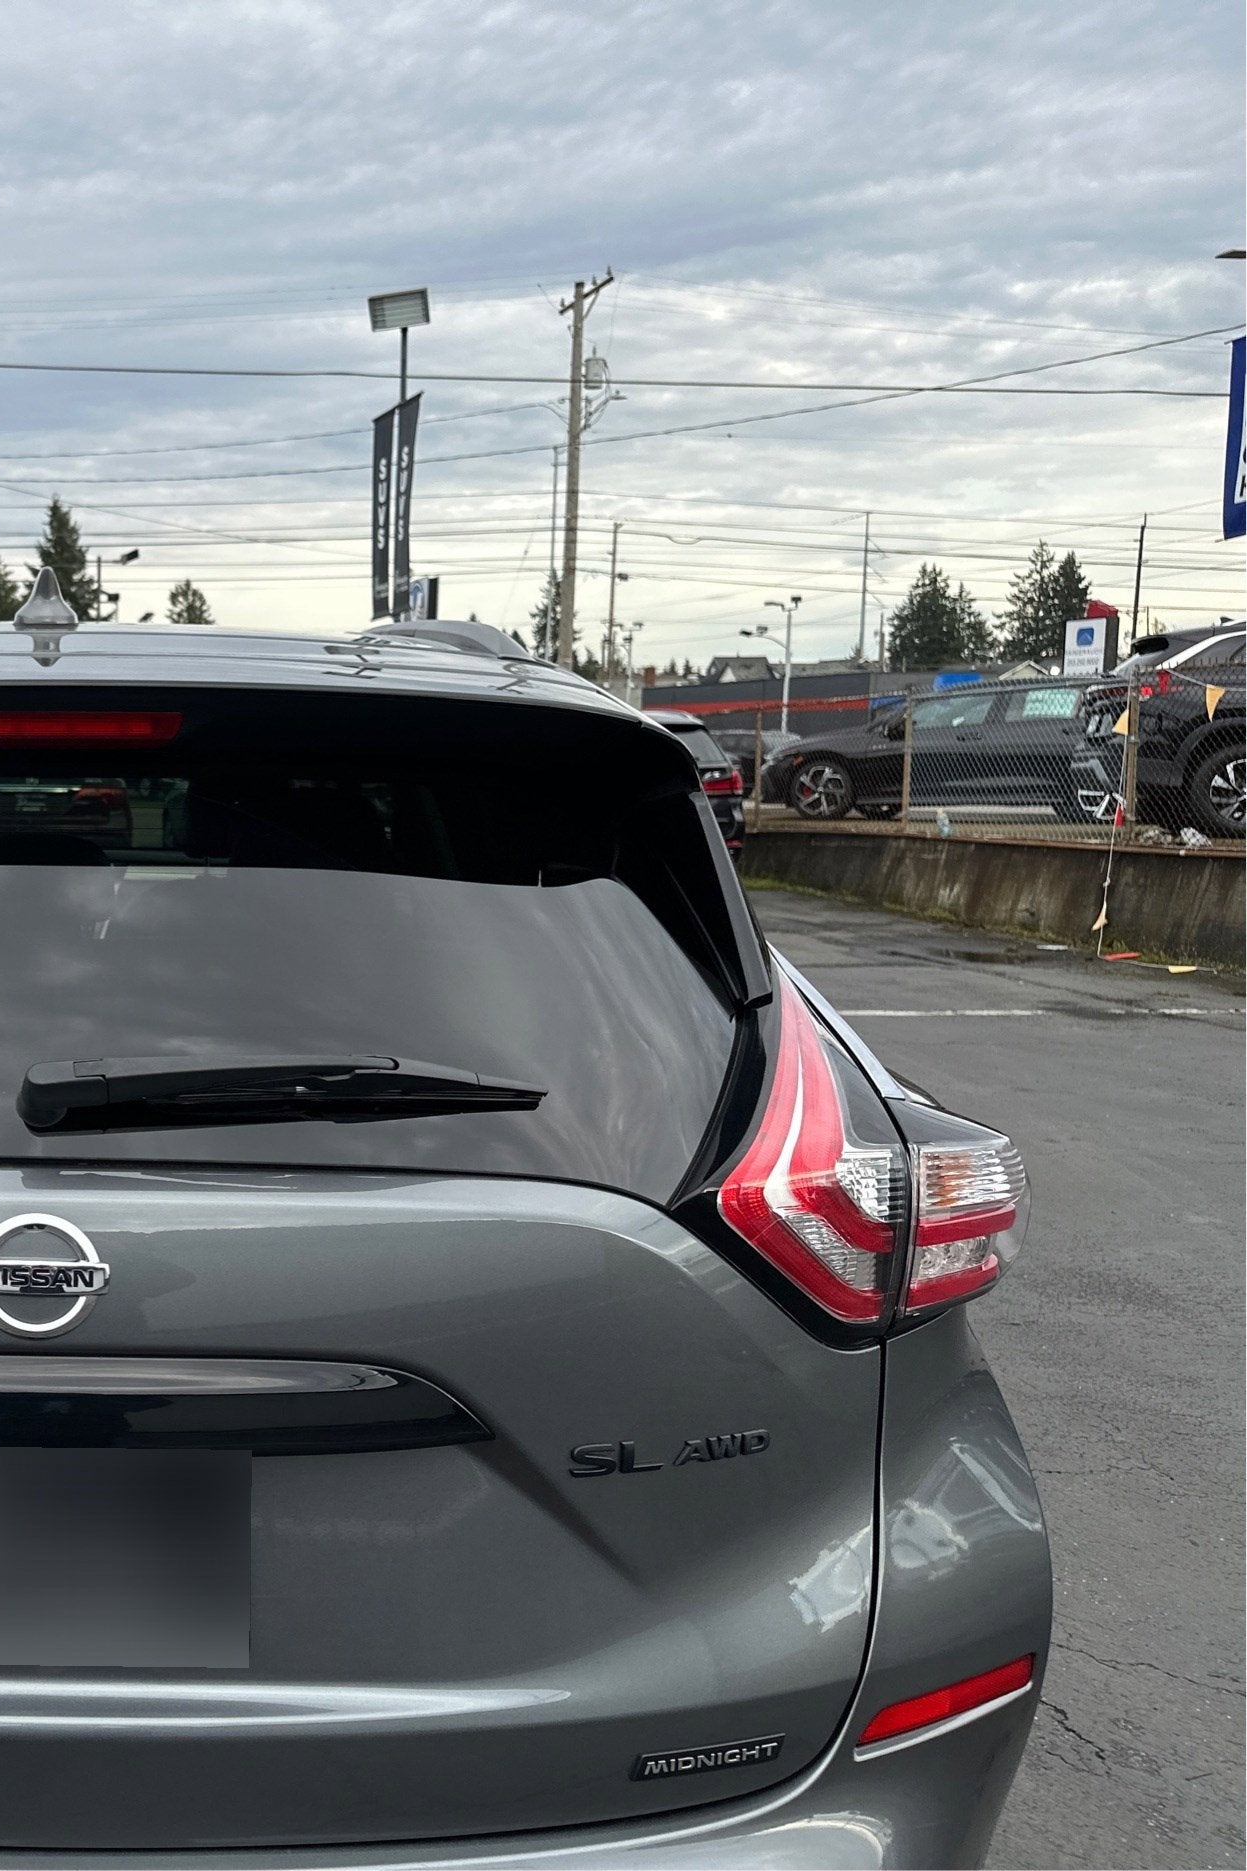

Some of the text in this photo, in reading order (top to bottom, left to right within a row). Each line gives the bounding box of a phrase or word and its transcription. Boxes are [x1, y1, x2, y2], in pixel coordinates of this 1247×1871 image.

[569, 1428, 771, 1478] SL AWD
[644, 1742, 778, 1776] MIDNIGHT
